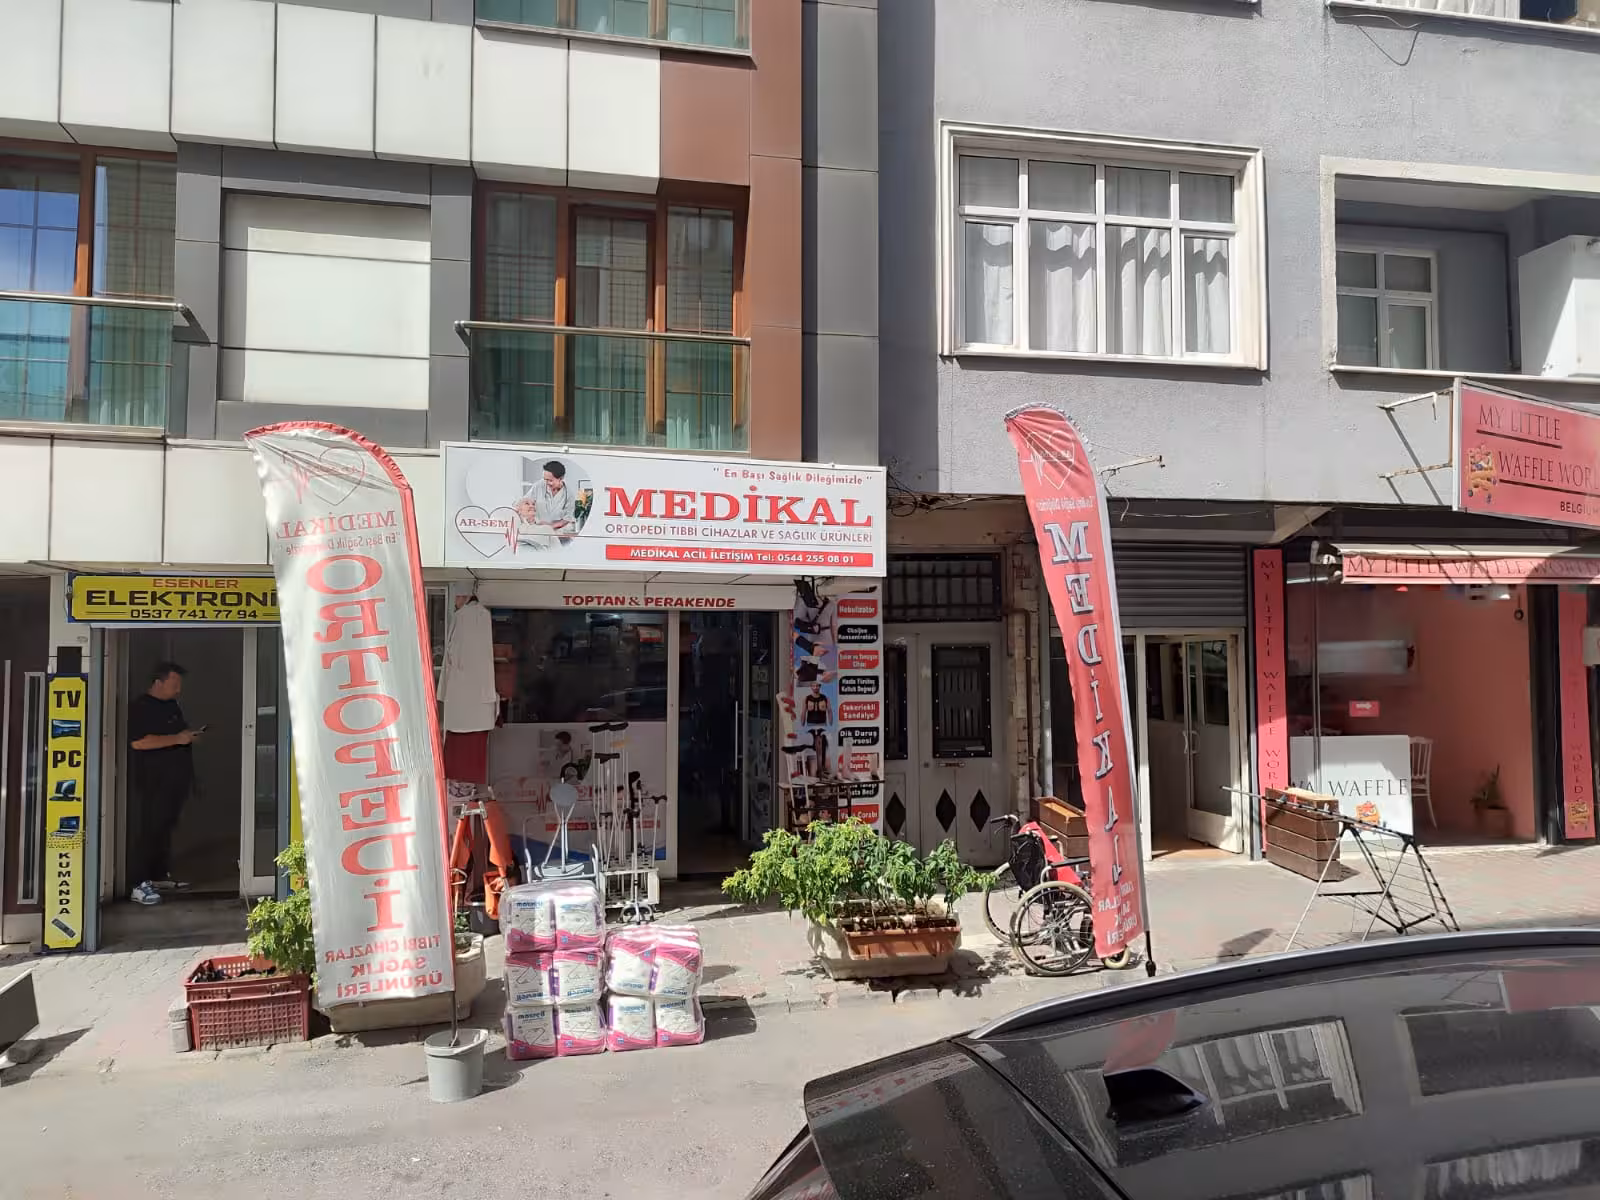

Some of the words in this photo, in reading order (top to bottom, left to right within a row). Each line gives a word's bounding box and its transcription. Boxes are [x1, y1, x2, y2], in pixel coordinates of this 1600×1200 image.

[1480, 404, 1504, 429] MY
[1511, 410, 1561, 441] LITTLE
[1498, 451, 1554, 482] WAFFLE
[742, 469, 765, 483] Başı
[769, 471, 803, 484] Sağlık
[604, 485, 873, 527] MEDİKAL
[459, 518, 509, 528] AR-SEM
[605, 523, 666, 535] ORTOPEDİ
[701, 526, 757, 539] CİHAZLAR
[761, 530, 775, 539] VE
[778, 529, 816, 541] SAĞLIK
[820, 530, 873, 543] ÜRÜNLERİ
[630, 548, 679, 559] MEDİKAL
[683, 549, 708, 560] ACİL
[710, 549, 754, 561] İLETİŞİM
[757, 553, 774, 561] Tel:
[778, 554, 803, 562] 0544
[806, 554, 825, 563] 255
[827, 555, 840, 563] 08
[842, 555, 854, 563] 01
[1348, 558, 1376, 574] MY
[1384, 559, 1447, 574] LITTLE
[153, 578, 239, 589] ESENLER
[562, 595, 626, 606] TOPTAN
[628, 596, 641, 606] &
[644, 596, 736, 608] PERAKENDE
[130, 609, 170, 619] 0537
[177, 609, 208, 619] 741
[214, 609, 232, 619] 77
[237, 610, 258, 619] 94
[53, 690, 82, 709] TV
[52, 750, 82, 769] PC
[1328, 778, 1408, 797] WAFFLE
[57, 851, 72, 915] KUMANDA
